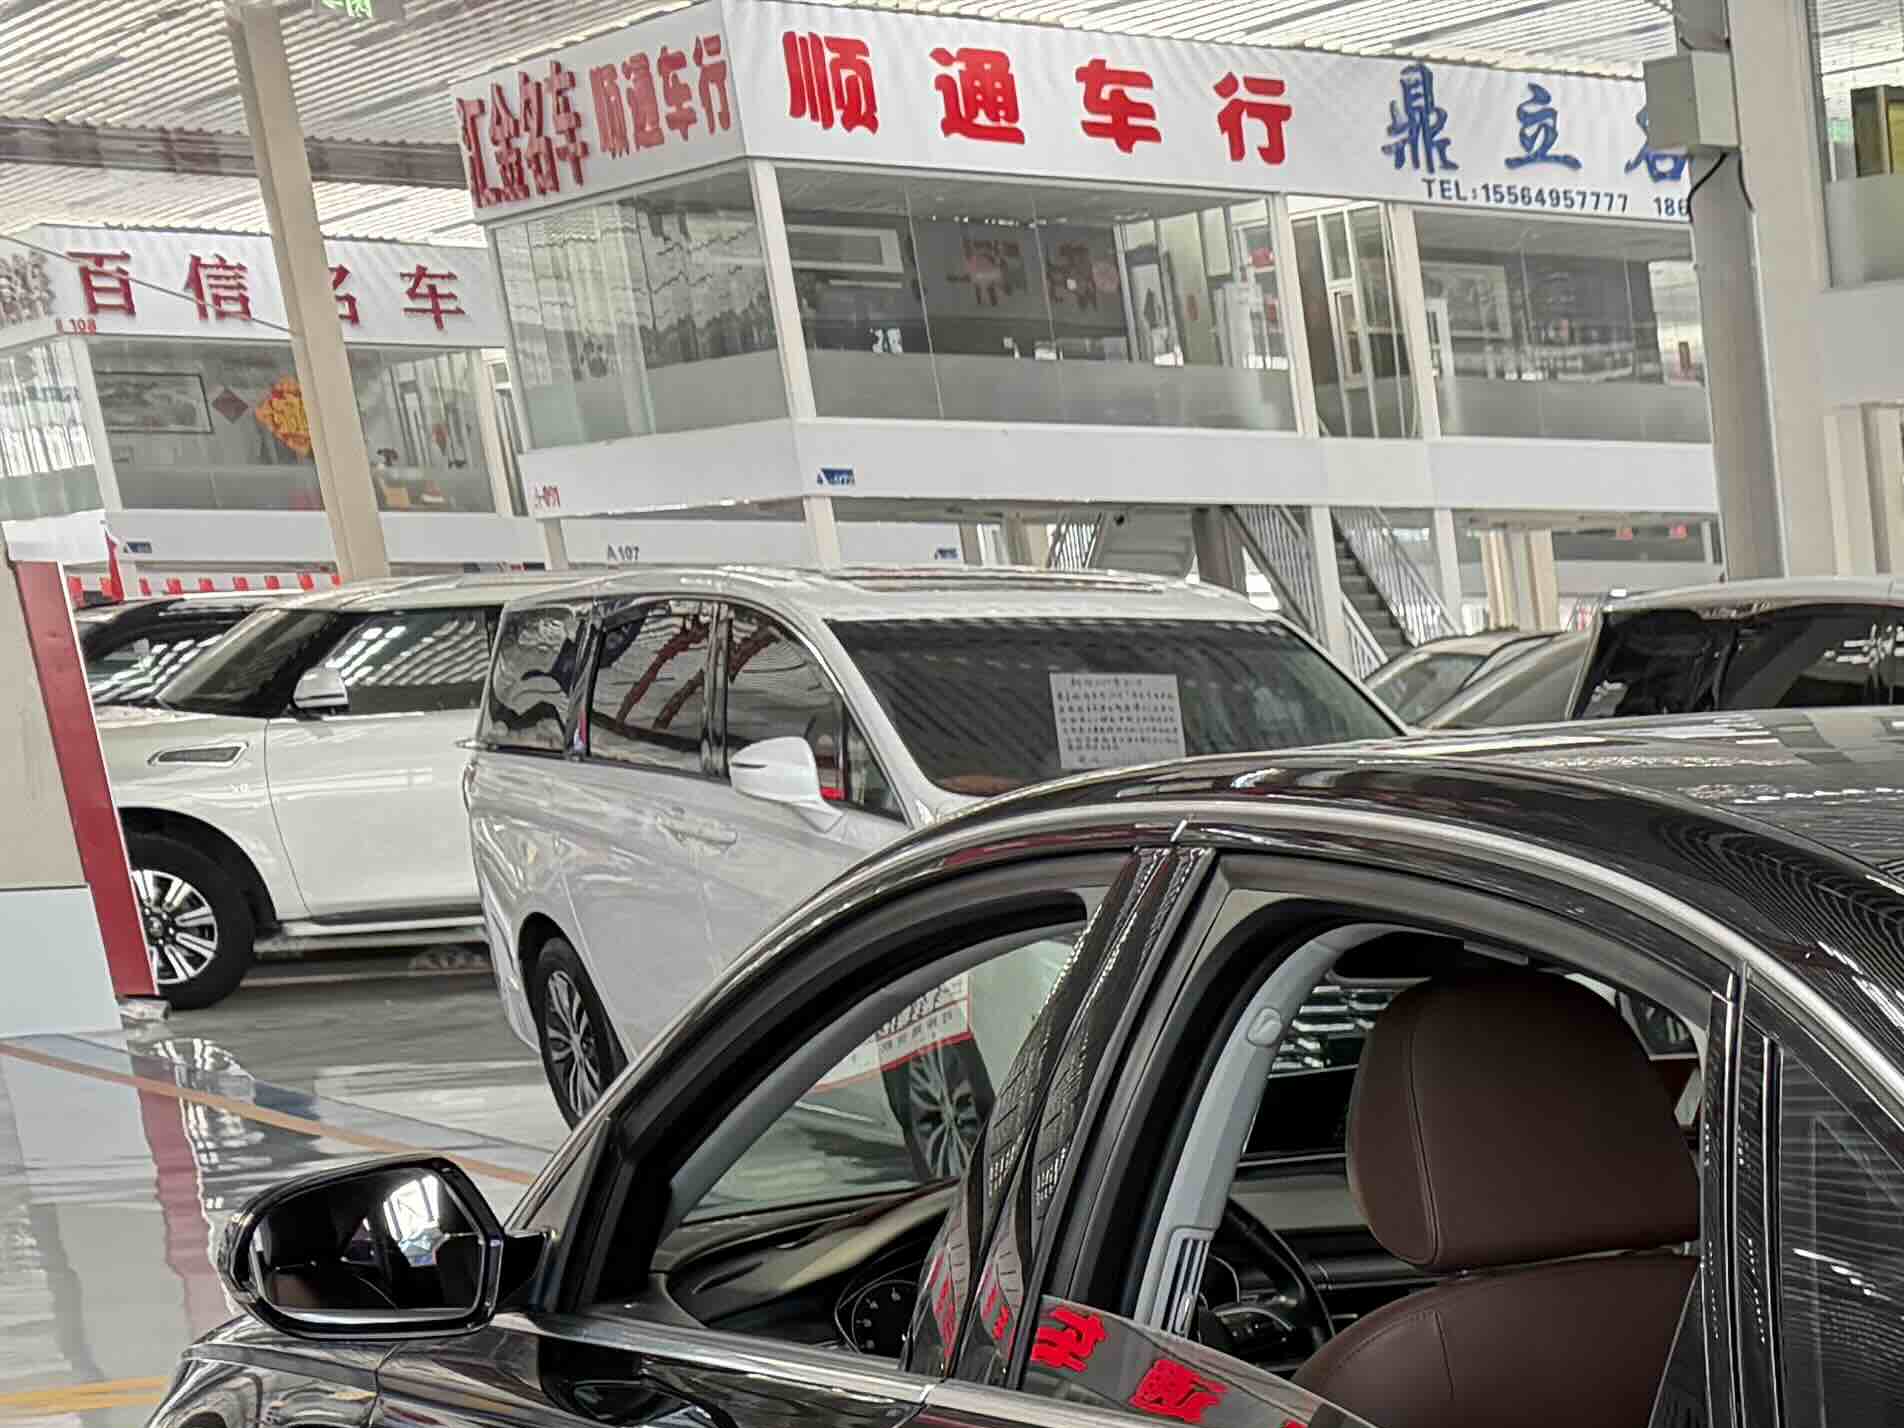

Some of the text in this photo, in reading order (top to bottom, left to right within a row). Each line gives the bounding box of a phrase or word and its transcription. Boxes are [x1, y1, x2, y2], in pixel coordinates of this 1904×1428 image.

[589, 34, 731, 158] 顺通车行
[783, 31, 1292, 165] 顺通车行
